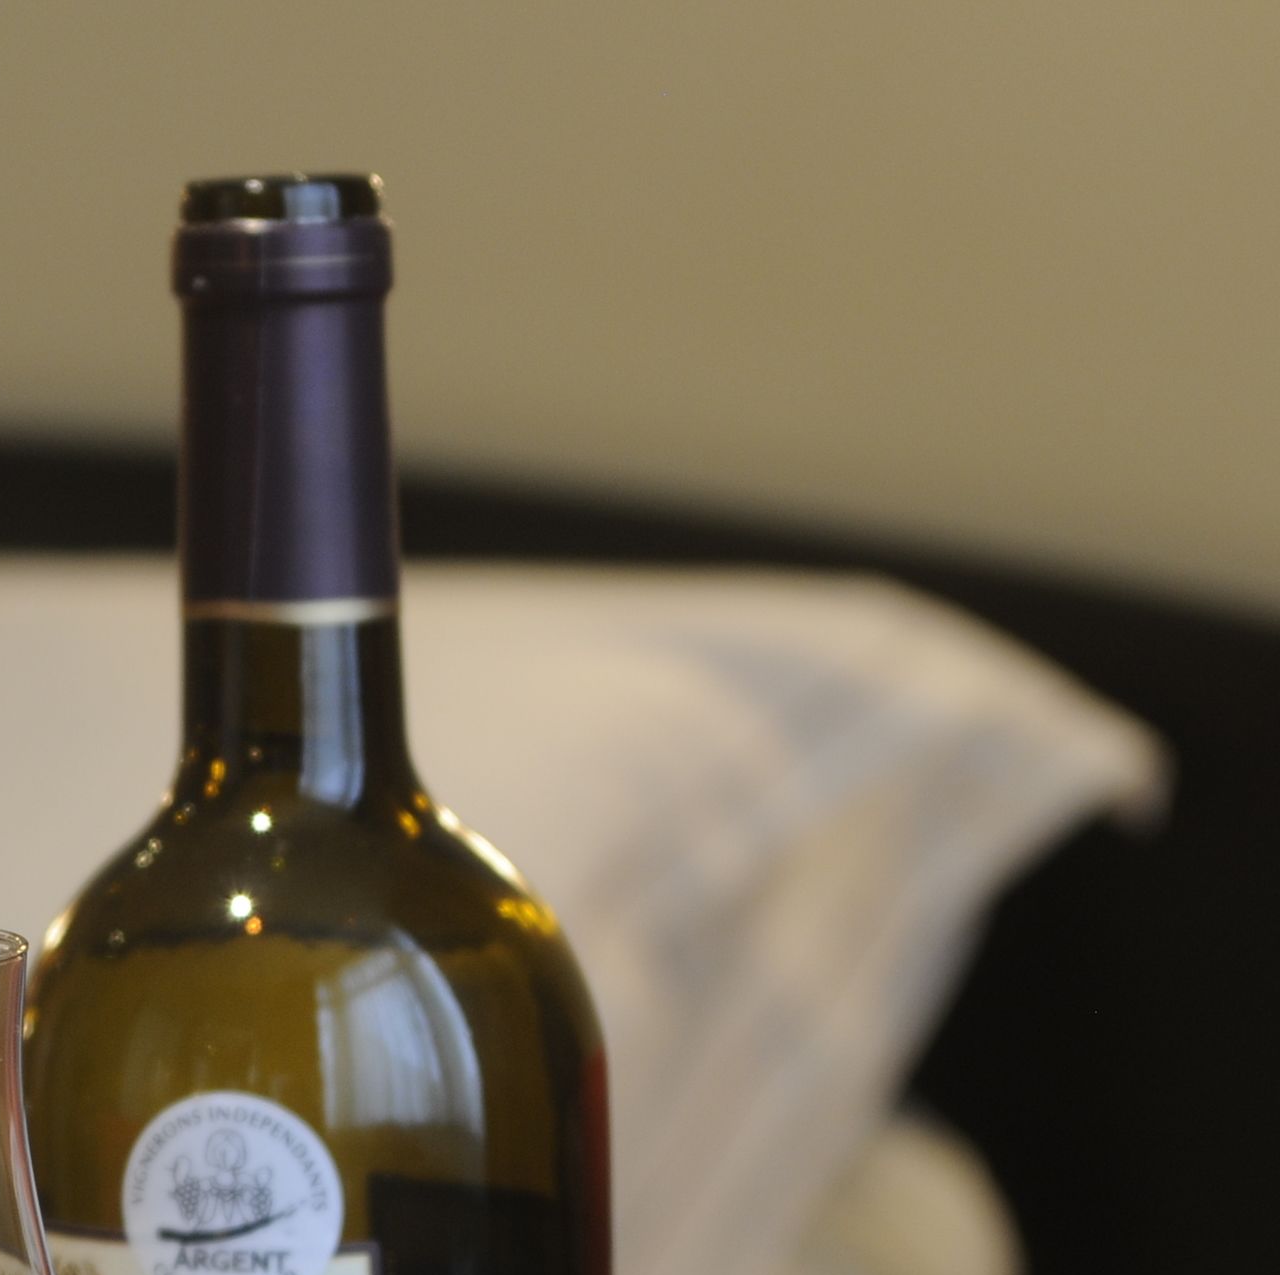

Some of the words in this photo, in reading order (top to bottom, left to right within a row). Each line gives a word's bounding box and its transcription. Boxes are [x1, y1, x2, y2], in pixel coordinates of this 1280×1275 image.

[131, 1106, 202, 1205] VIGNERONS
[207, 1105, 328, 1213] INDEPENDANTS
[173, 1247, 290, 1274] ARGENT
